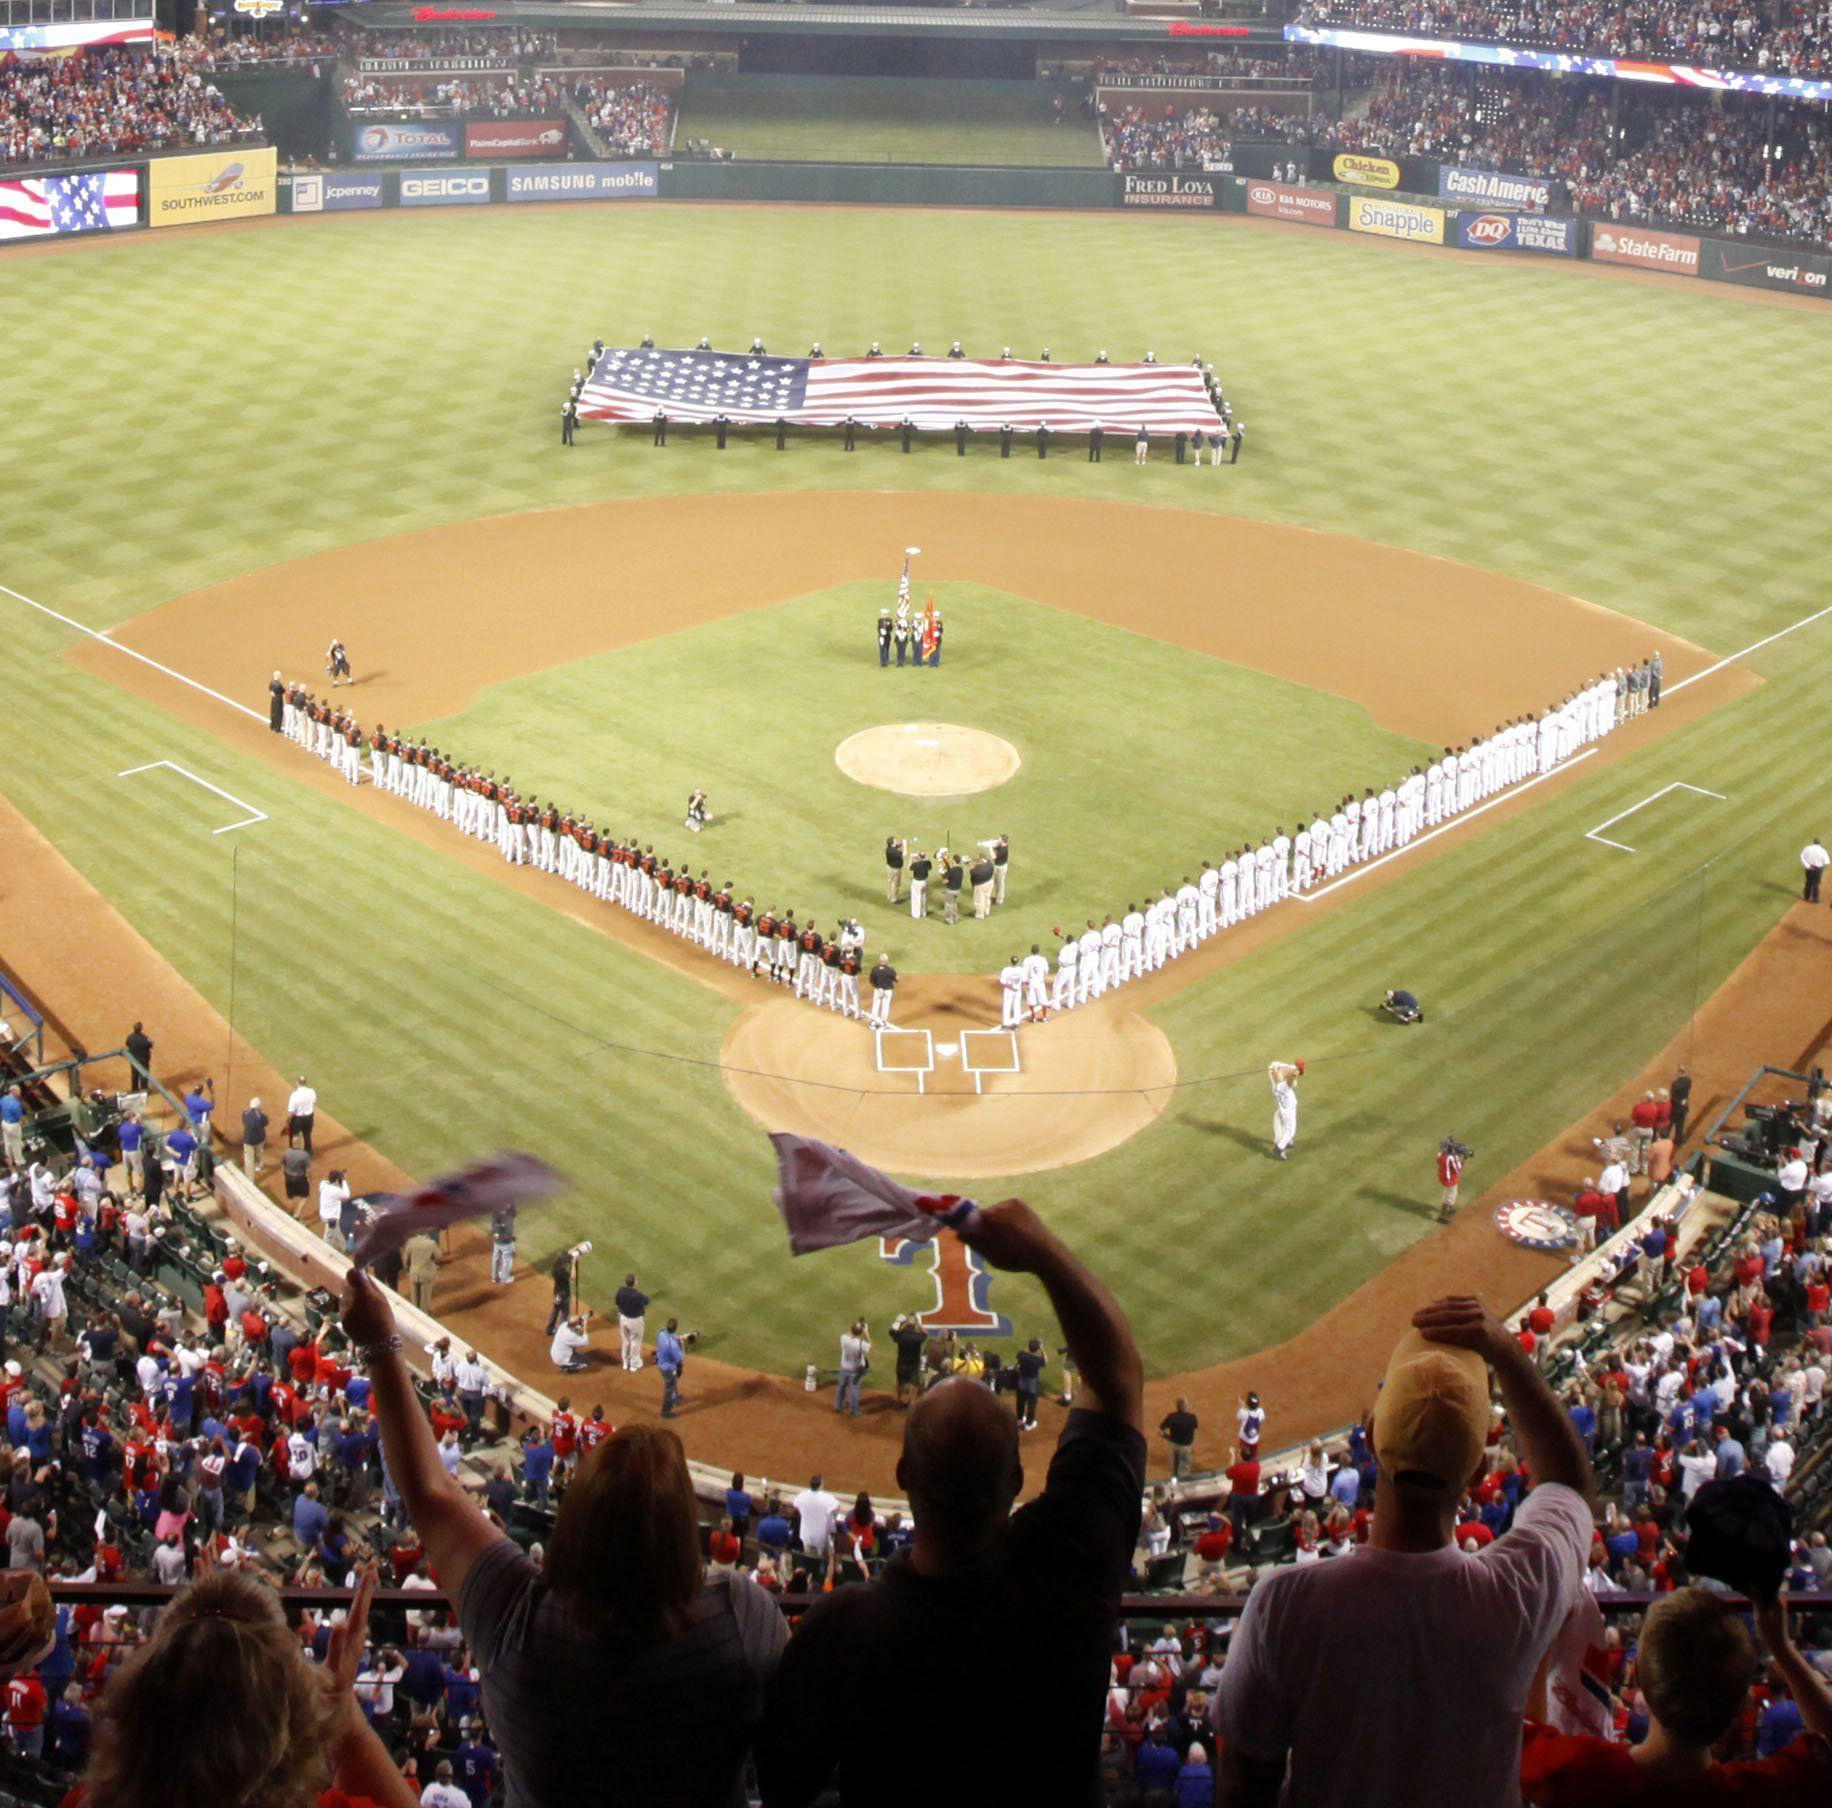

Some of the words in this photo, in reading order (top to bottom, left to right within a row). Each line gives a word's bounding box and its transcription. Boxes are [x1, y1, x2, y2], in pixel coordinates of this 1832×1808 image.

[396, 131, 451, 146] TOTAL
[1342, 157, 1390, 176] Chicken
[401, 178, 489, 197] GEICO
[511, 174, 596, 192] SAMSUNG
[325, 184, 380, 200] jcpenney
[1124, 194, 1214, 206] INSURANCE
[1254, 190, 1273, 202] KIA
[161, 190, 264, 212] SOUTHWEST.COM
[1279, 195, 1294, 205] KIA
[1295, 196, 1332, 212] MOTORS
[1359, 203, 1434, 236] Snapple
[1475, 222, 1504, 239] DQ
[1767, 265, 1827, 288] verizon
[83, 1444, 97, 1459] 12
